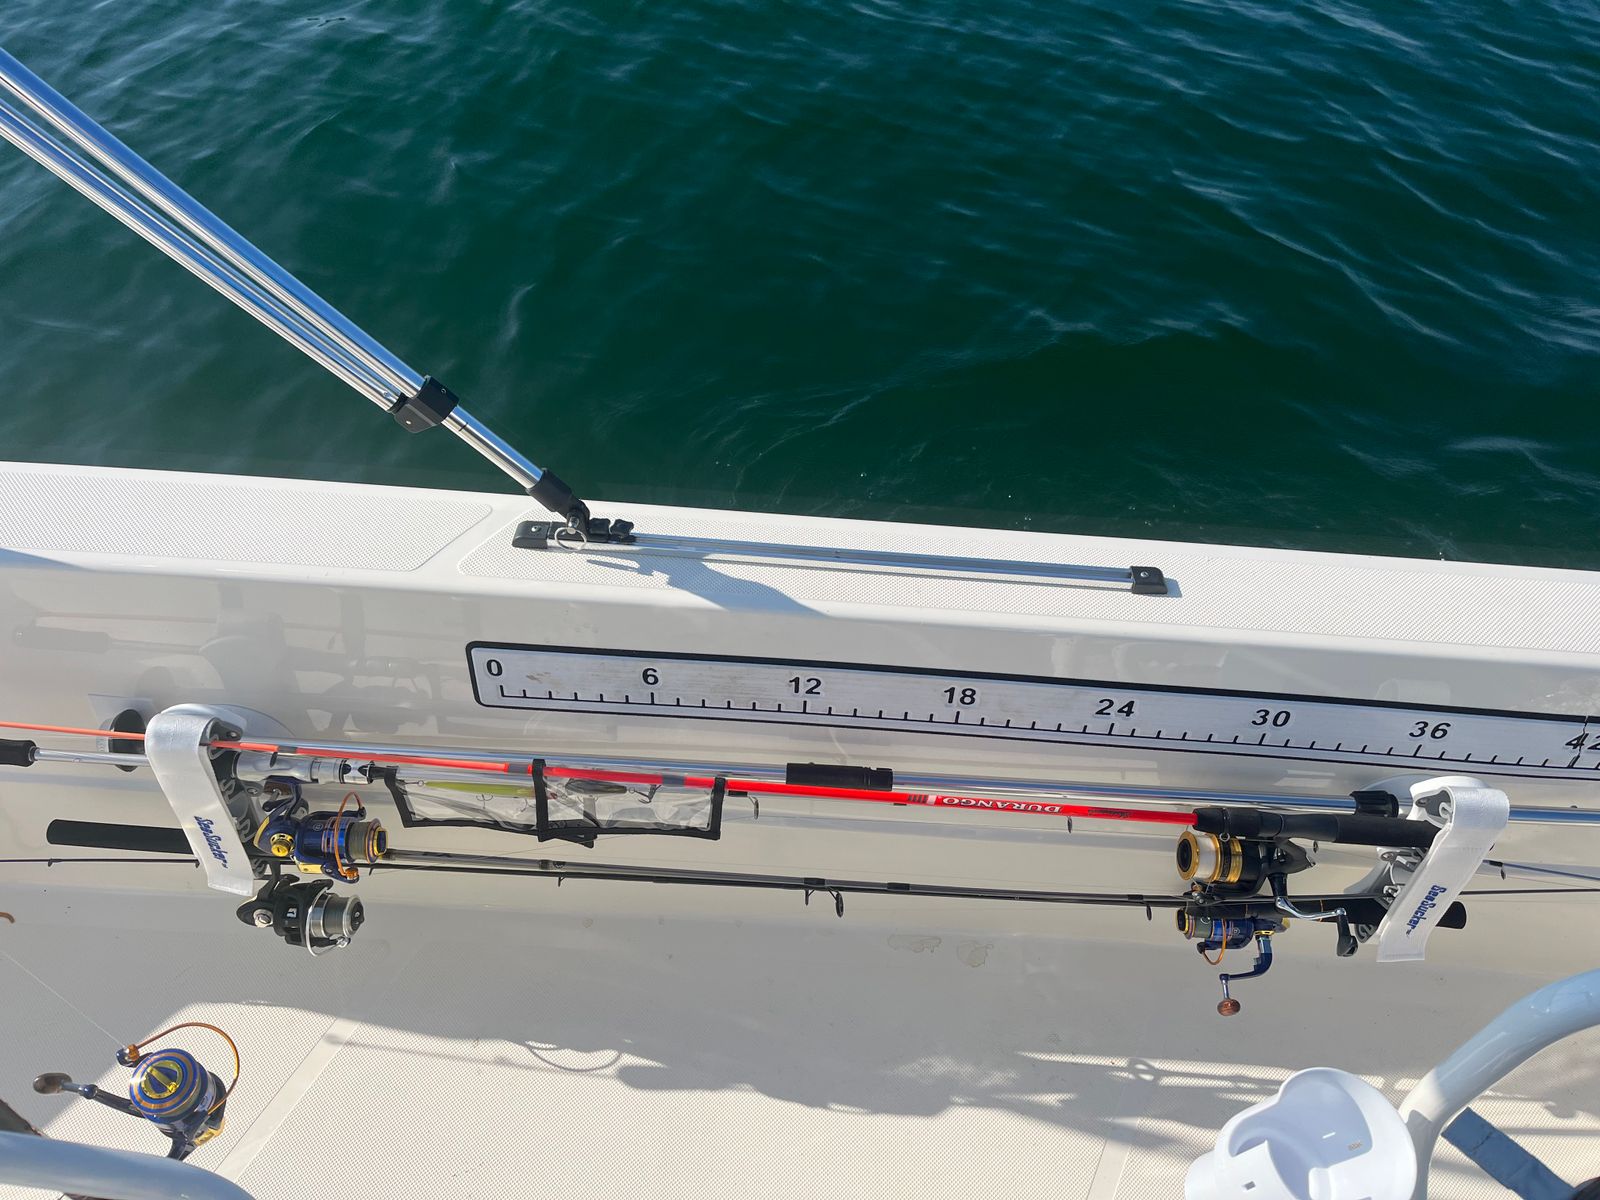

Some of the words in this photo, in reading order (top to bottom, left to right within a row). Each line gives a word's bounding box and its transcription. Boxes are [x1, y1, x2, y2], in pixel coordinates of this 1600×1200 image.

[486, 659, 503, 677] 0
[642, 667, 659, 686] 6
[788, 676, 822, 695] 12
[943, 686, 977, 706] 18
[1094, 698, 1136, 718] 24
[1251, 709, 1291, 728] 30
[1408, 720, 1452, 740] 36
[942, 795, 1062, 814] DURANGO
